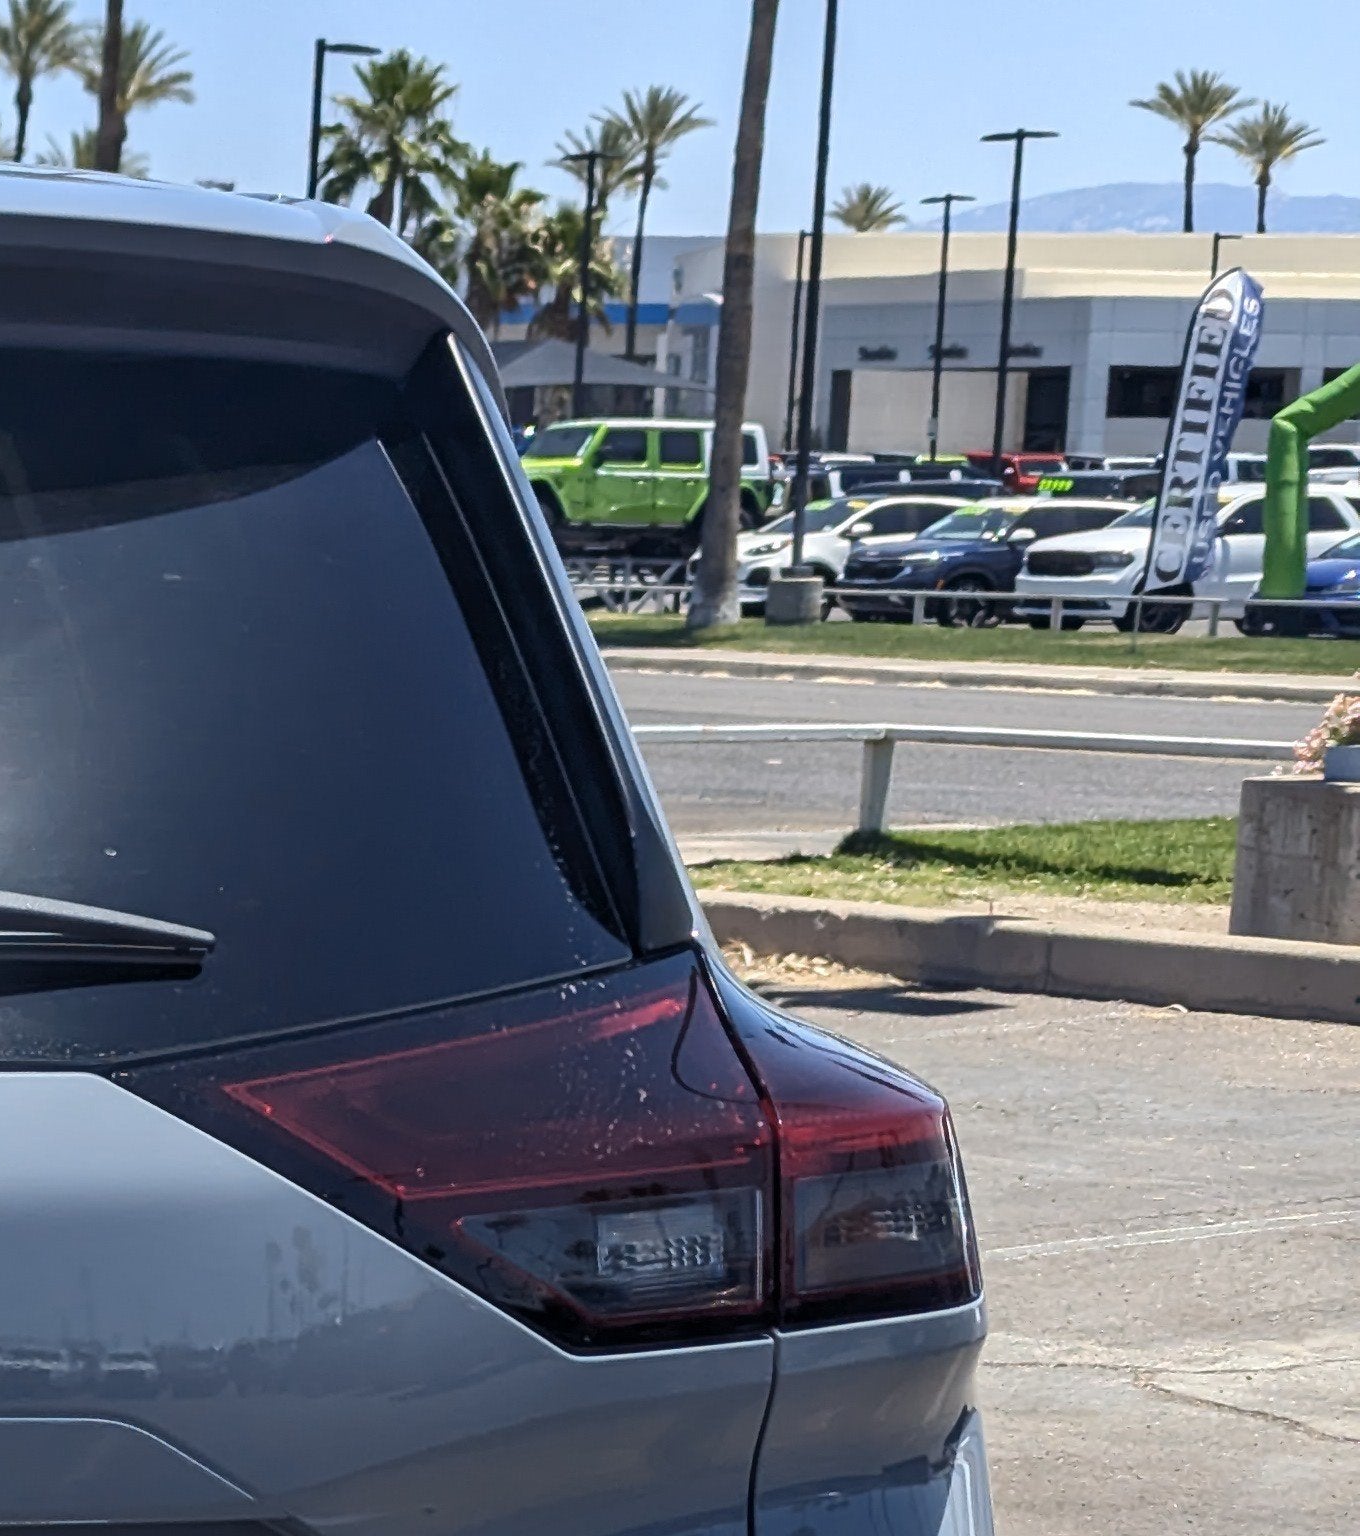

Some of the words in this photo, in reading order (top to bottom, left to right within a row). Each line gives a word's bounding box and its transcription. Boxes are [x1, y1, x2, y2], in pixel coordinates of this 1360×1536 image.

[1153, 288, 1235, 583] CERTIFIED
[1189, 470, 1223, 564] USED
[1214, 296, 1261, 462] VEHICLES
